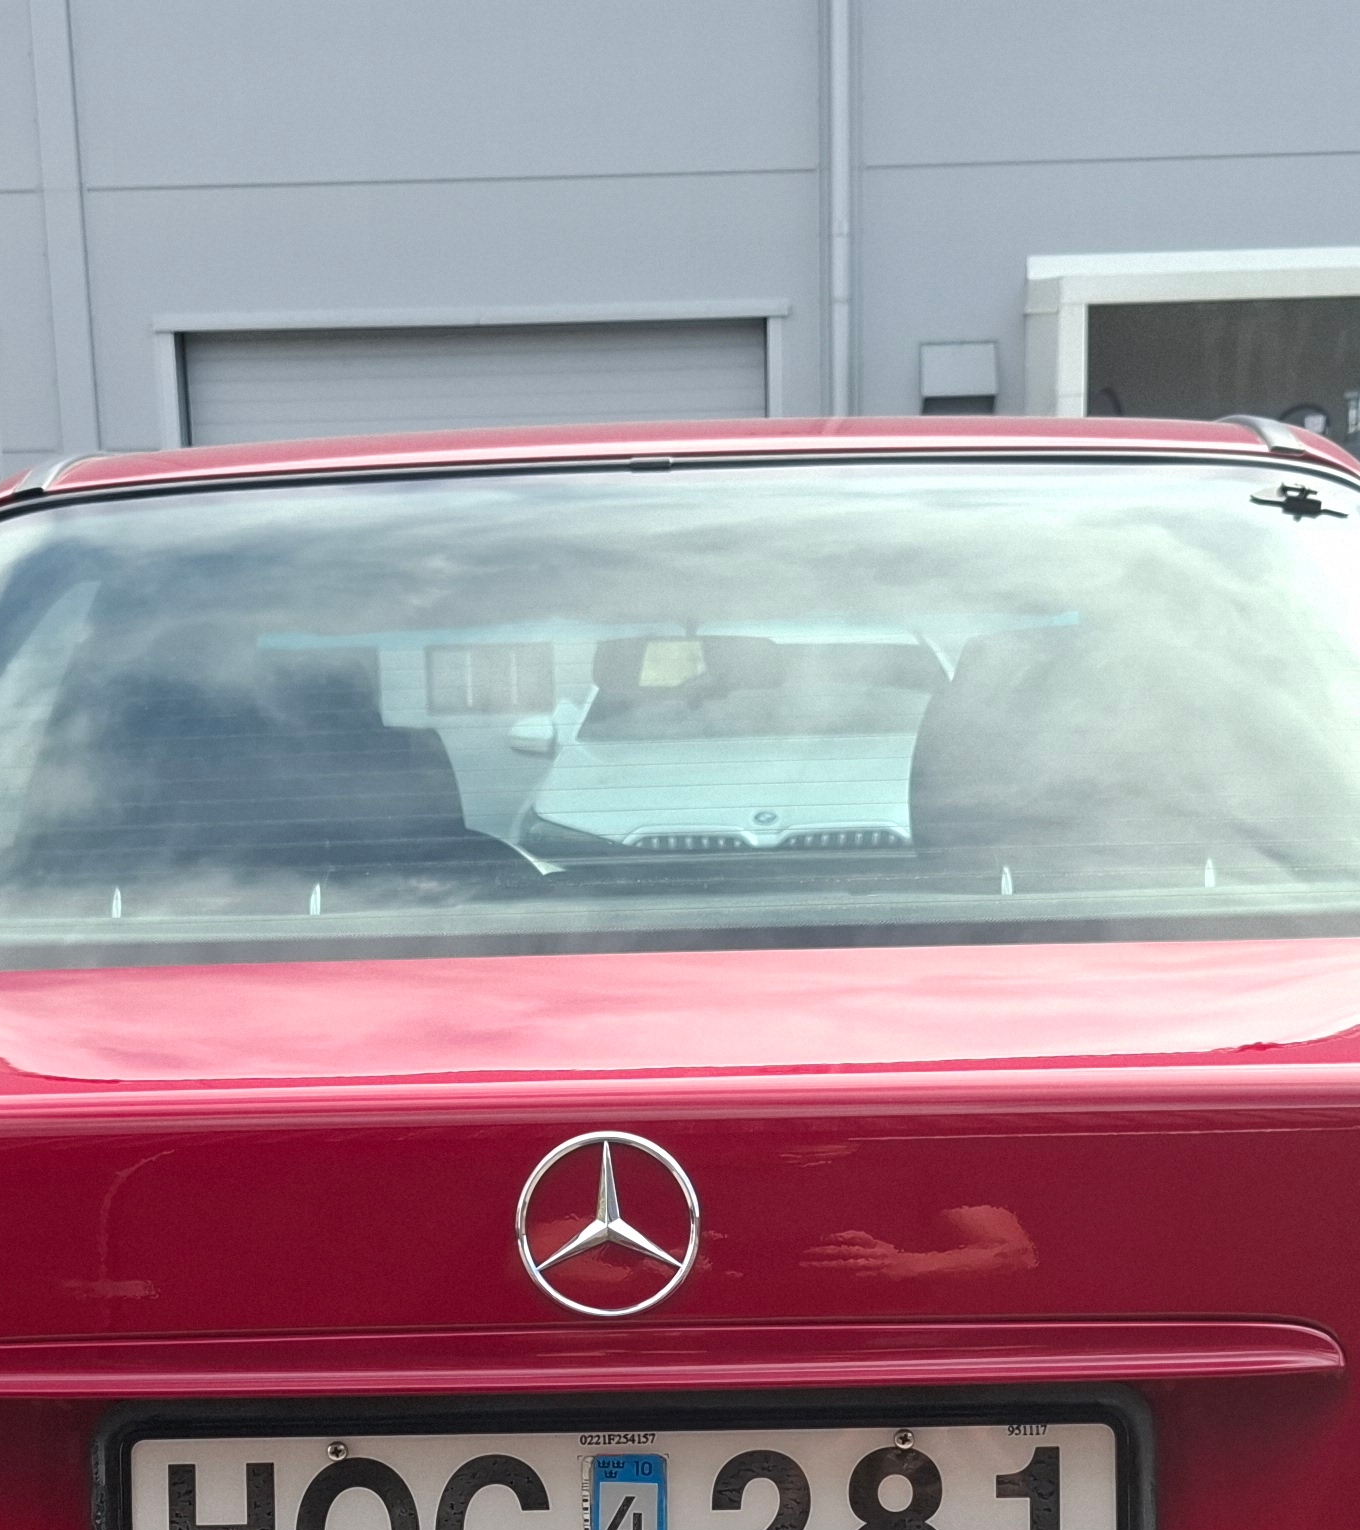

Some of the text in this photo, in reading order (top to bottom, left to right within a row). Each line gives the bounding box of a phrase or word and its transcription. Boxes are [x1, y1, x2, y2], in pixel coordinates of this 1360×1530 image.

[1007, 1424, 1048, 1436] 951117
[579, 1433, 656, 1446] 0221F254157
[633, 1460, 653, 1477] 10
